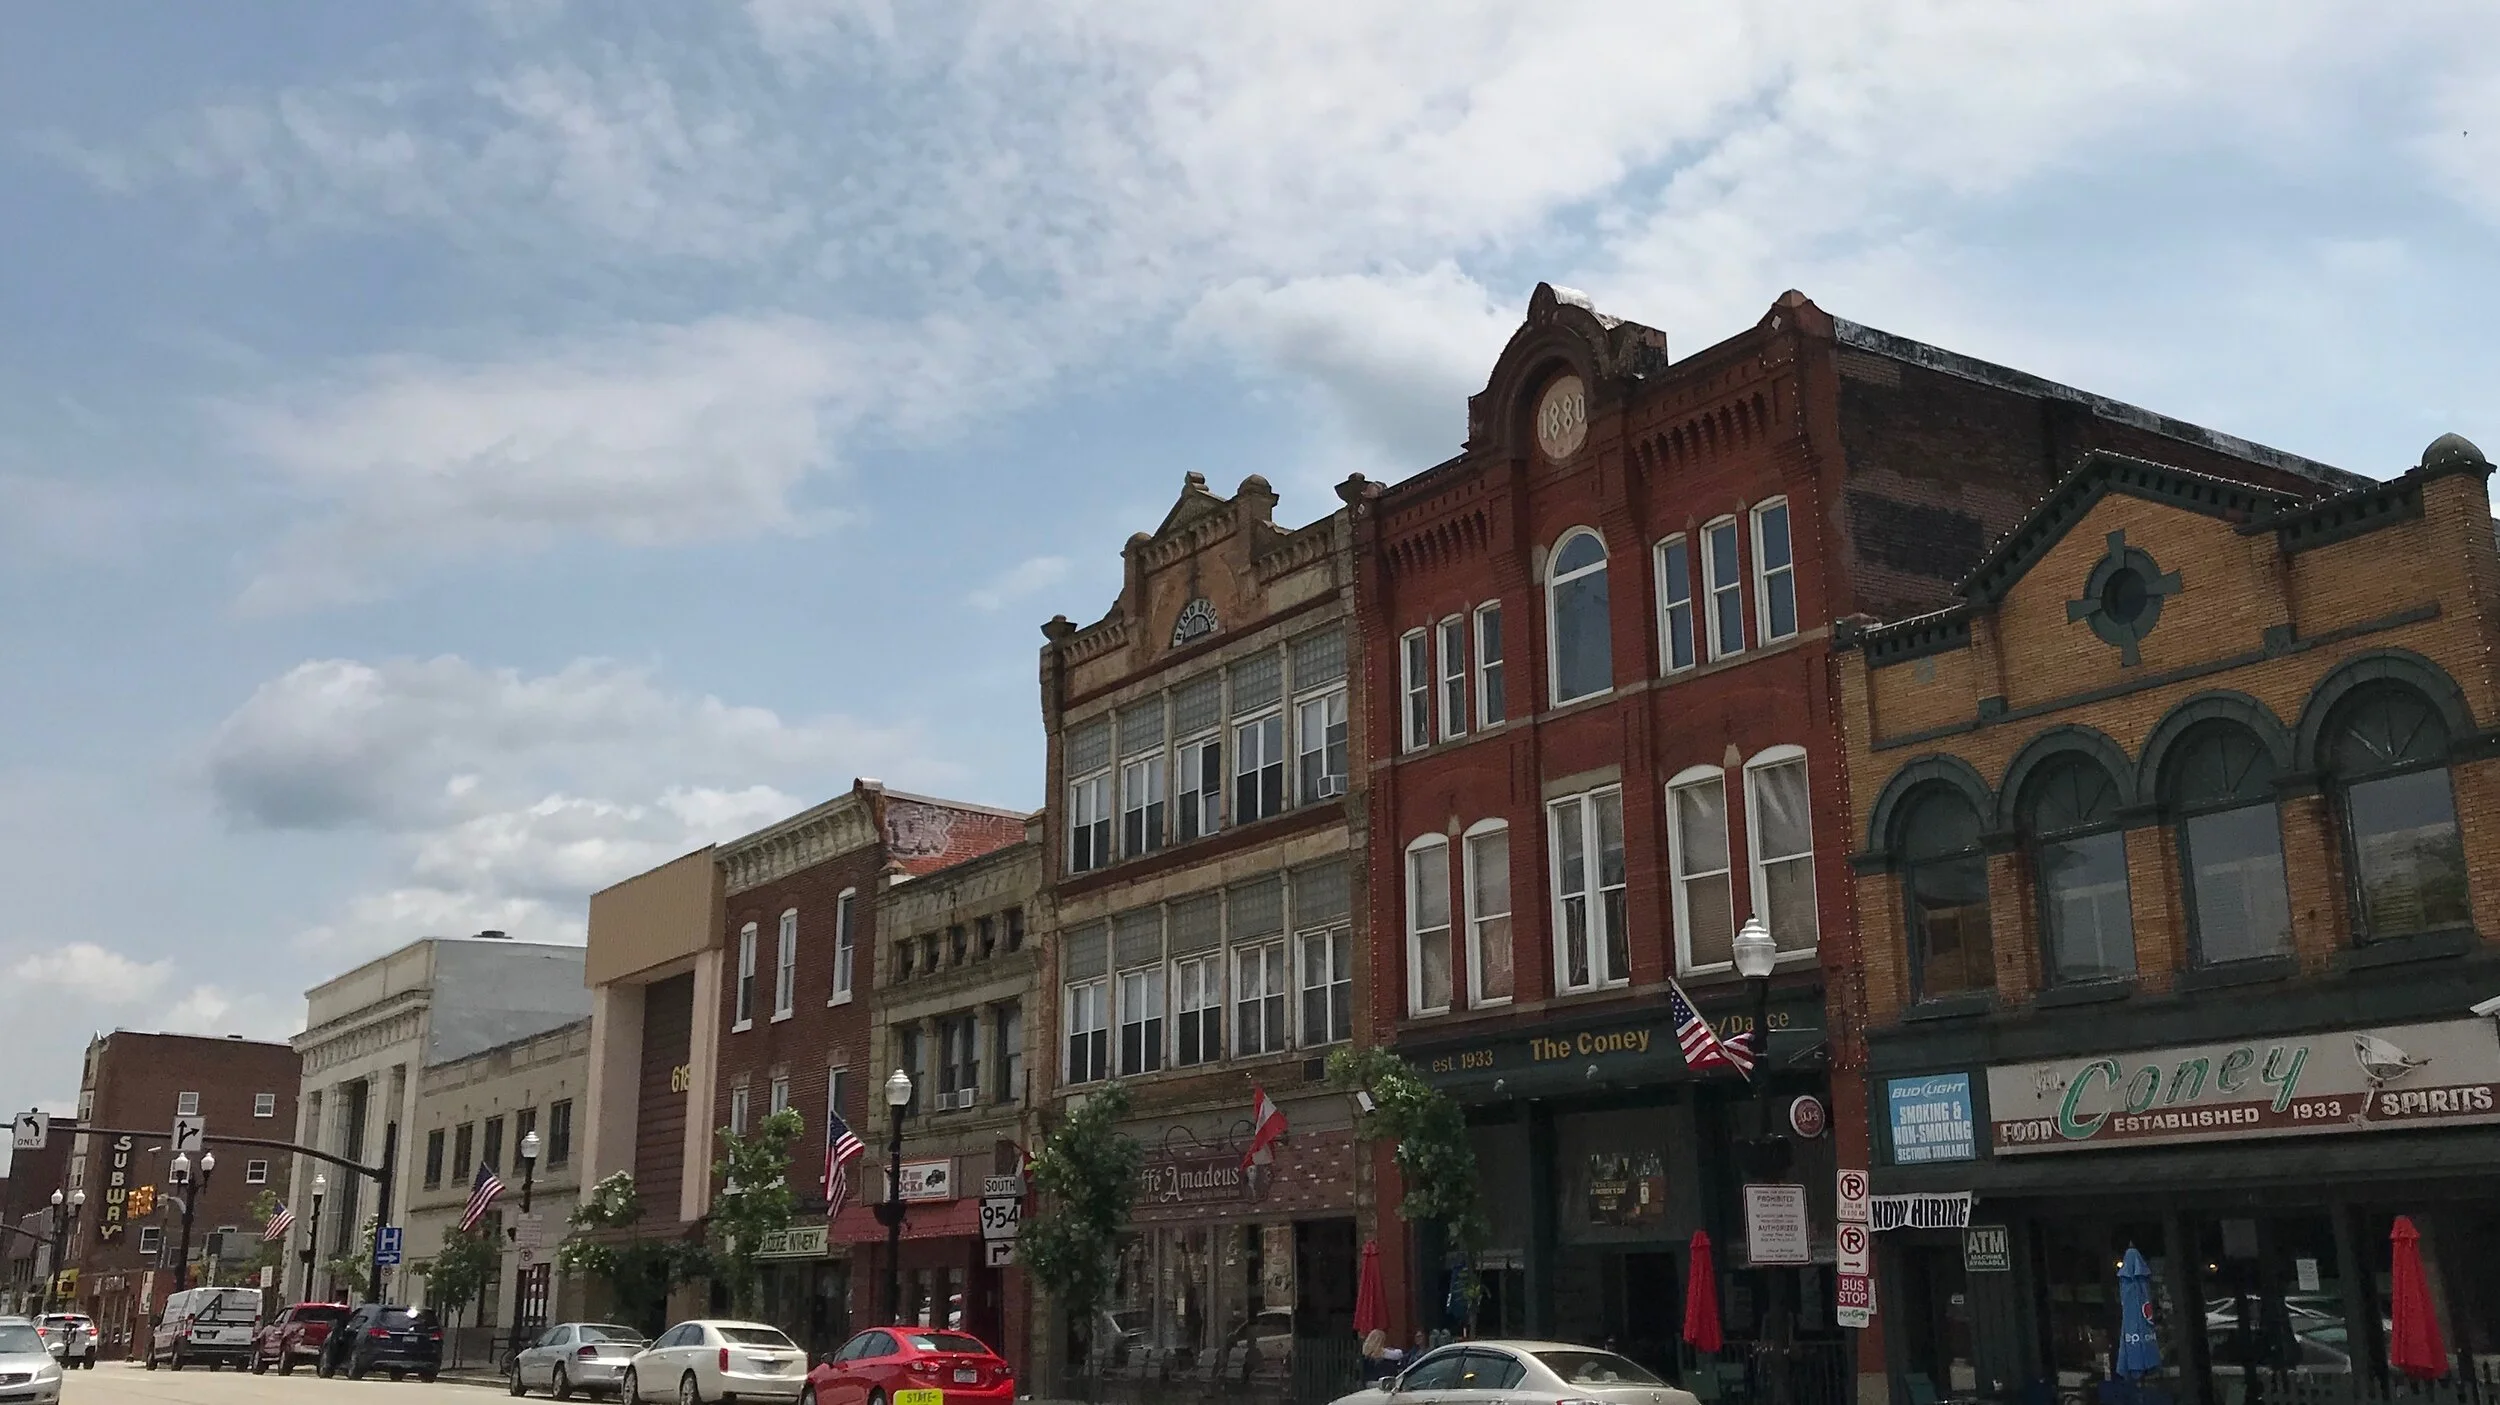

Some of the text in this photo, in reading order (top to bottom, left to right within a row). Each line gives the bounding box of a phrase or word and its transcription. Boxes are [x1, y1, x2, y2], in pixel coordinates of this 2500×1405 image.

[1542, 394, 1585, 439] 1880
[1461, 1049, 1494, 1070] 1933
[1529, 1036, 1572, 1061] The
[1576, 1028, 1650, 1055] Coney
[2057, 1044, 2310, 1140] Coney
[2380, 1085, 2494, 1117] SPIRITS
[1899, 1100, 1962, 1125] SMOKING &
[2113, 1100, 2343, 1133] ESTABLISHED 1933
[17, 1138, 41, 1147] ONLY
[1893, 1119, 1972, 1146] NON-SMOKING
[2000, 1120, 2053, 1143] FOOD
[1931, 1142, 1971, 1159] AVAILABLE
[100, 1135, 133, 1240] SUBWAY
[985, 1179, 1016, 1192] SOUTH
[982, 1205, 1020, 1229] 954
[1871, 1197, 1969, 1229] NOW HIRING
[1757, 1224, 1799, 1232] AUTHORIZED
[1967, 1230, 2006, 1254] ATM
[1841, 1279, 1865, 1291] BUS
[1838, 1291, 1868, 1304] STOP
